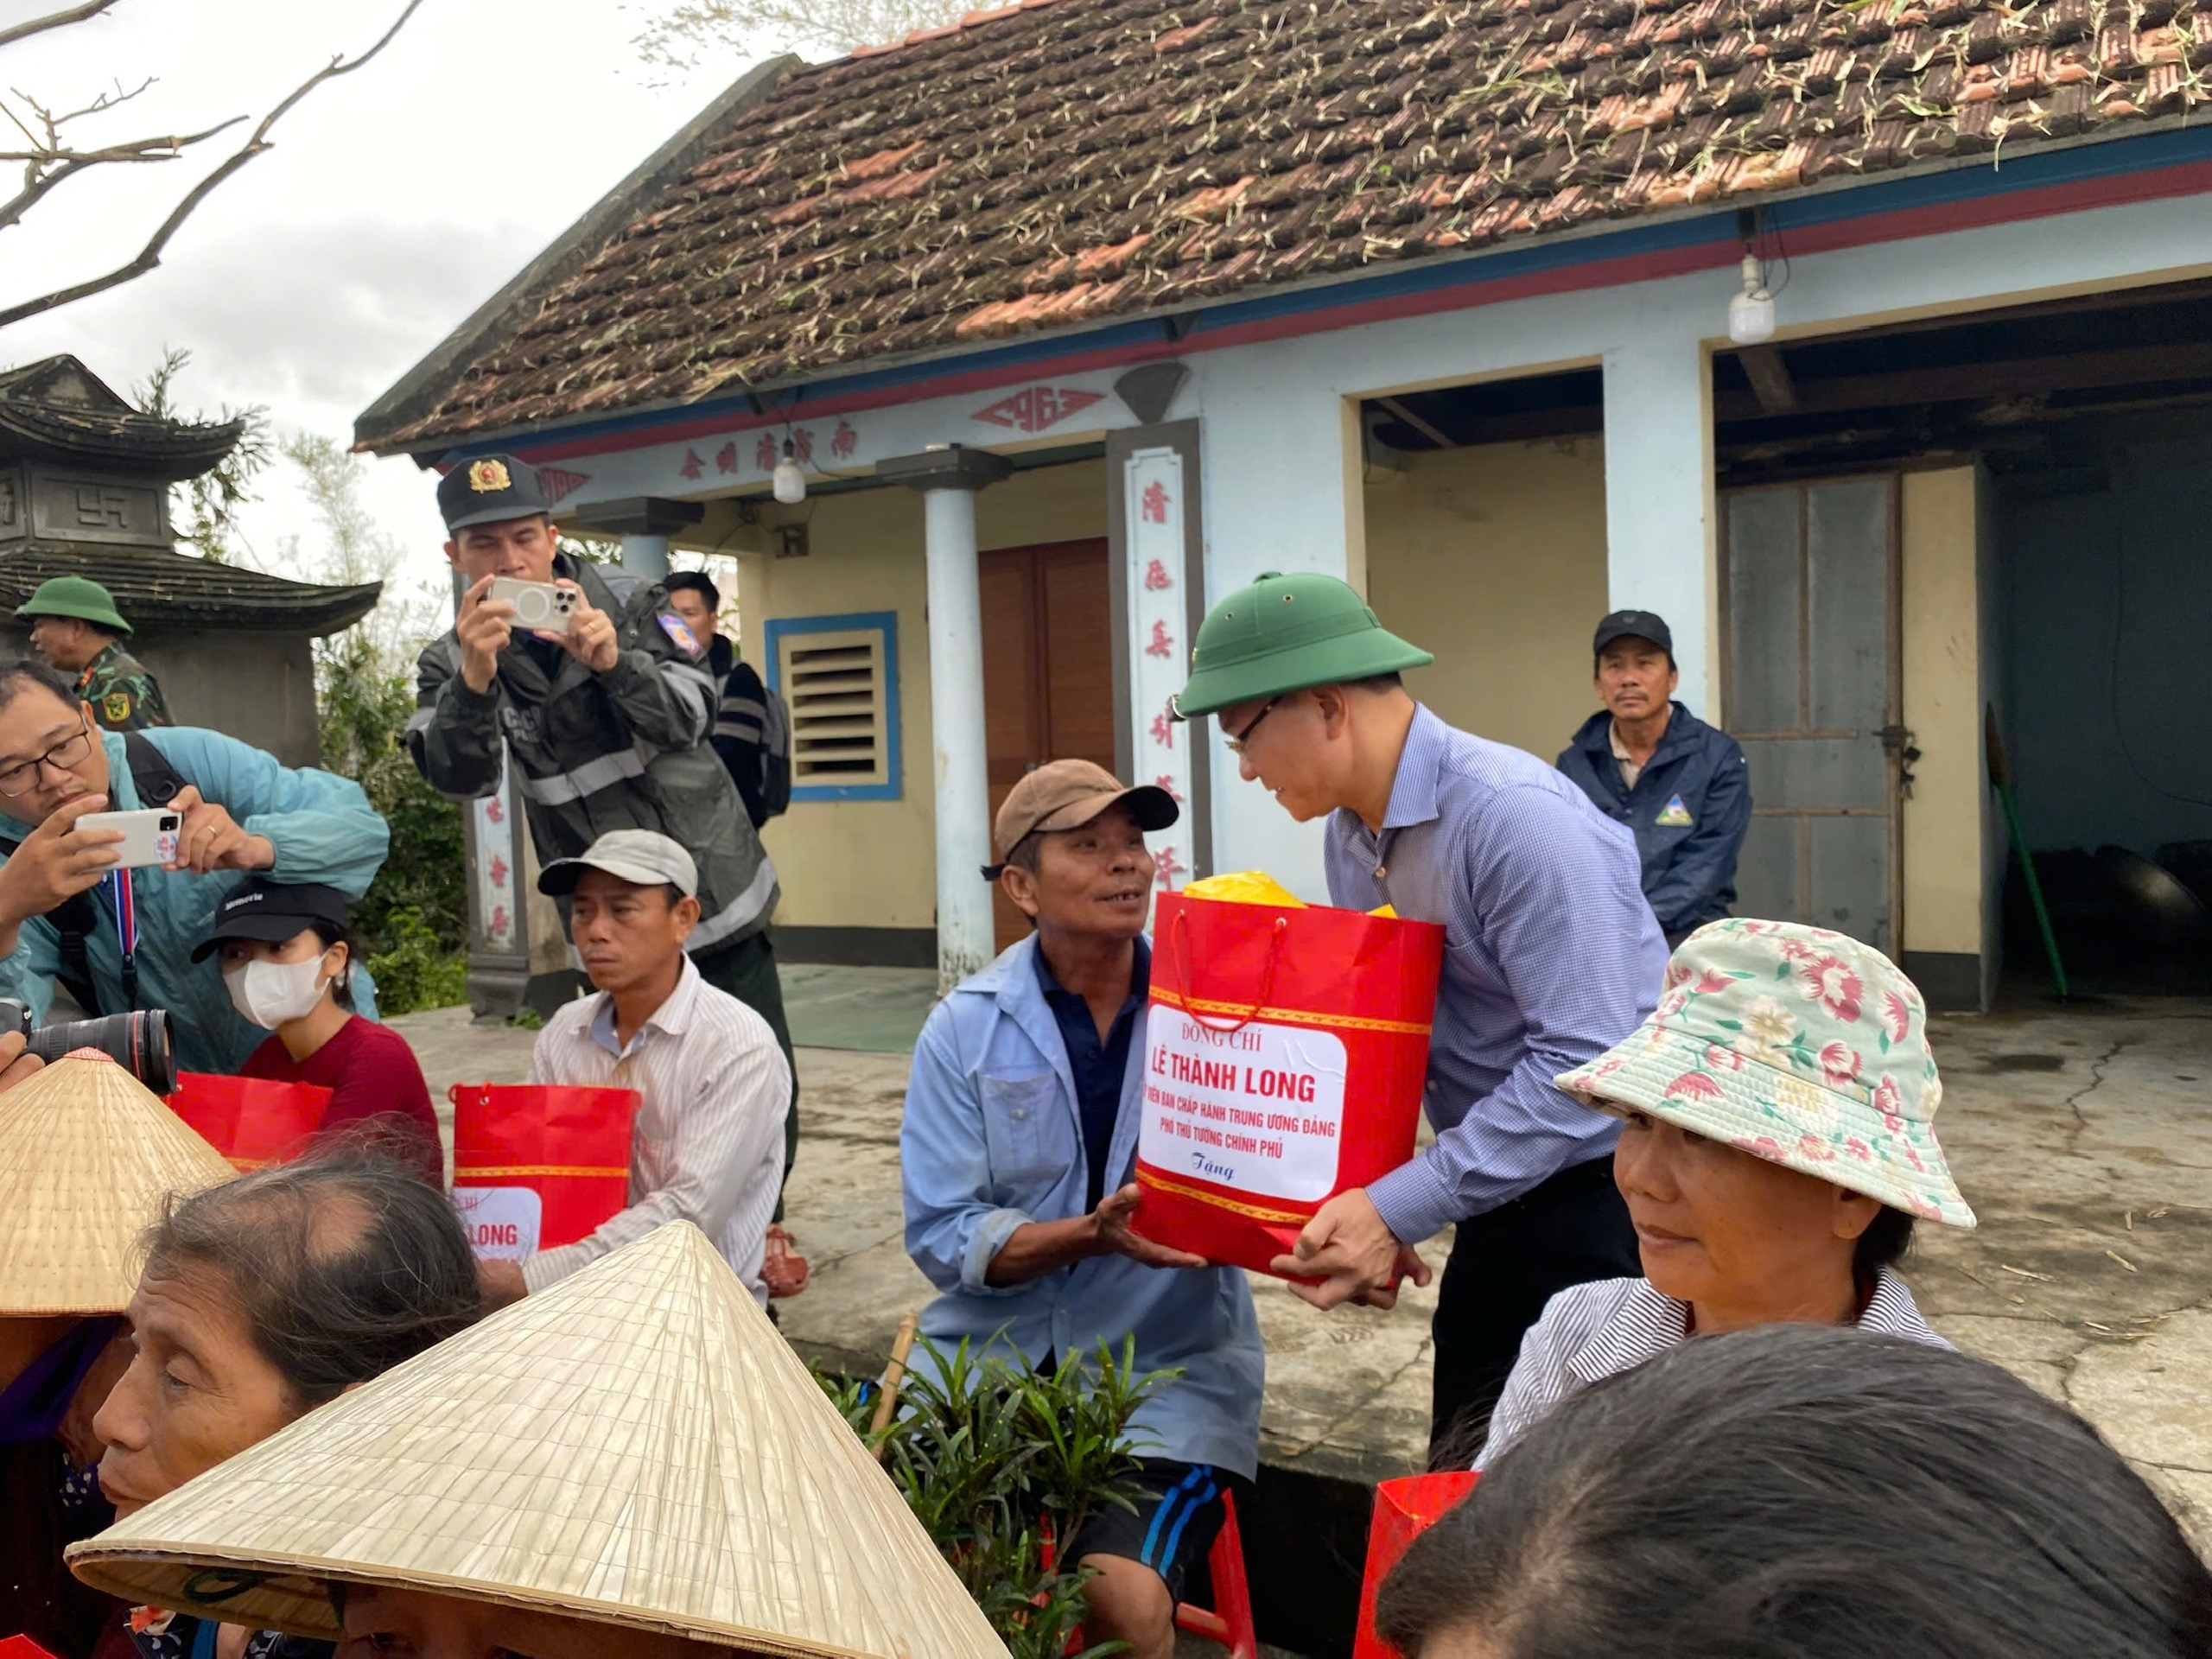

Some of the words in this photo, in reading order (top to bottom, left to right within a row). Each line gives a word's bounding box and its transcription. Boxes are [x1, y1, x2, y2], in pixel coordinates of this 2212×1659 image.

[1230, 1028, 1262, 1052] CHÍ
[1152, 1045, 1166, 1075] LÊ
[1171, 1053, 1236, 1091] THÀNH
[1244, 1067, 1315, 1103] LONG
[1161, 1091, 1175, 1109] BAN
[1200, 1101, 1226, 1121] HÀNH
[1229, 1108, 1263, 1129] TRUNG
[1267, 1113, 1300, 1133] ƯƠNG
[1303, 1115, 1335, 1137] ĐẢNG
[1176, 1120, 1191, 1138] THỦ
[1193, 1126, 1223, 1147] TƯỚNG
[1225, 1132, 1256, 1154] CHÍNH
[1260, 1136, 1283, 1159] PHỦ
[467, 1224, 517, 1246] LONG
